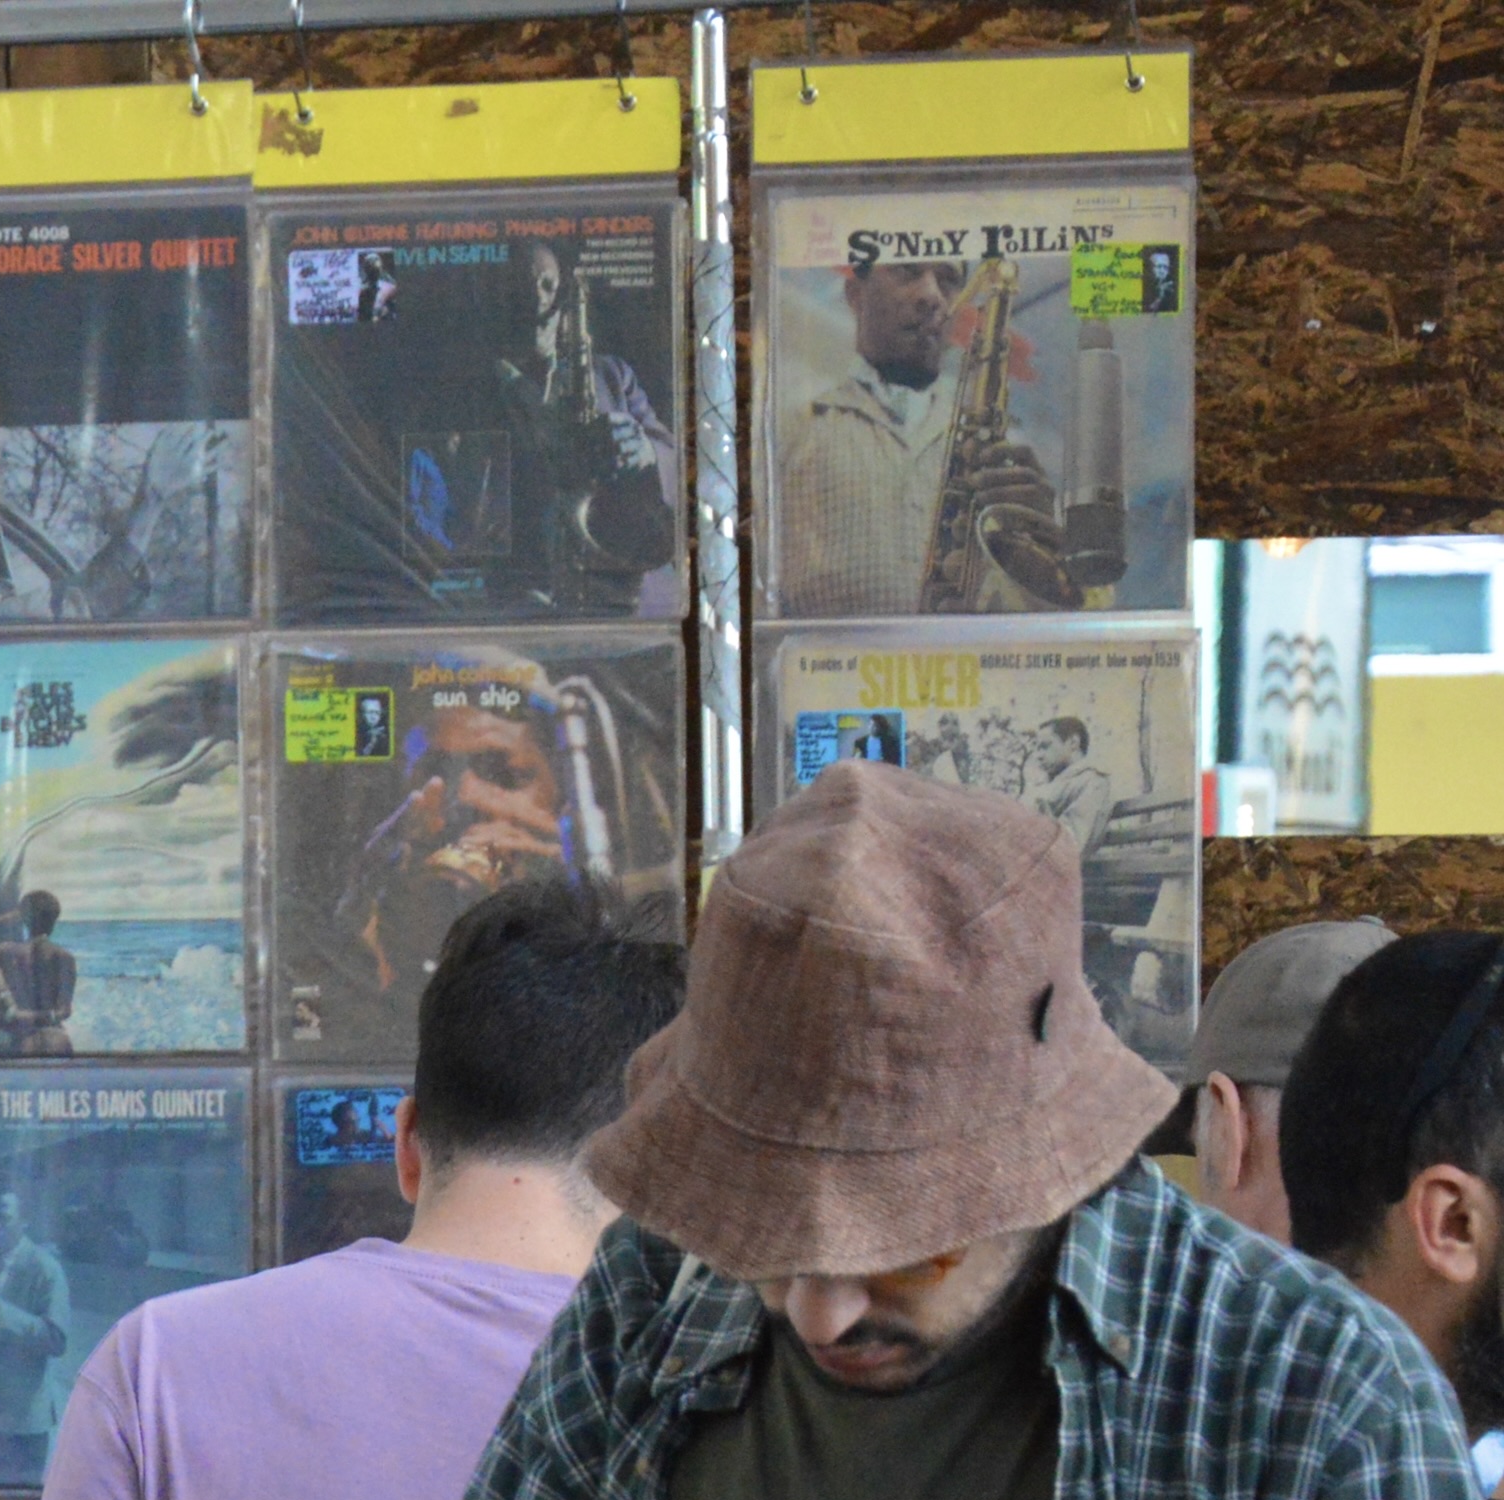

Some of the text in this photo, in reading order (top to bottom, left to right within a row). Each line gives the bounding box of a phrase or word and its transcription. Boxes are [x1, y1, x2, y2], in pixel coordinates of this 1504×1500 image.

[28, 225, 71, 241] 4008
[72, 241, 143, 273] SILVER
[150, 237, 237, 270] QUINTET
[411, 663, 455, 691] john
[857, 651, 982, 709] SILVER
[1025, 653, 1062, 669] SILVER
[432, 683, 522, 712] sun ship
[0, 1089, 34, 1119] THE
[38, 1089, 92, 1119] MILES
[96, 1089, 146, 1119] DAVIS
[150, 1088, 228, 1119] QUINTET
